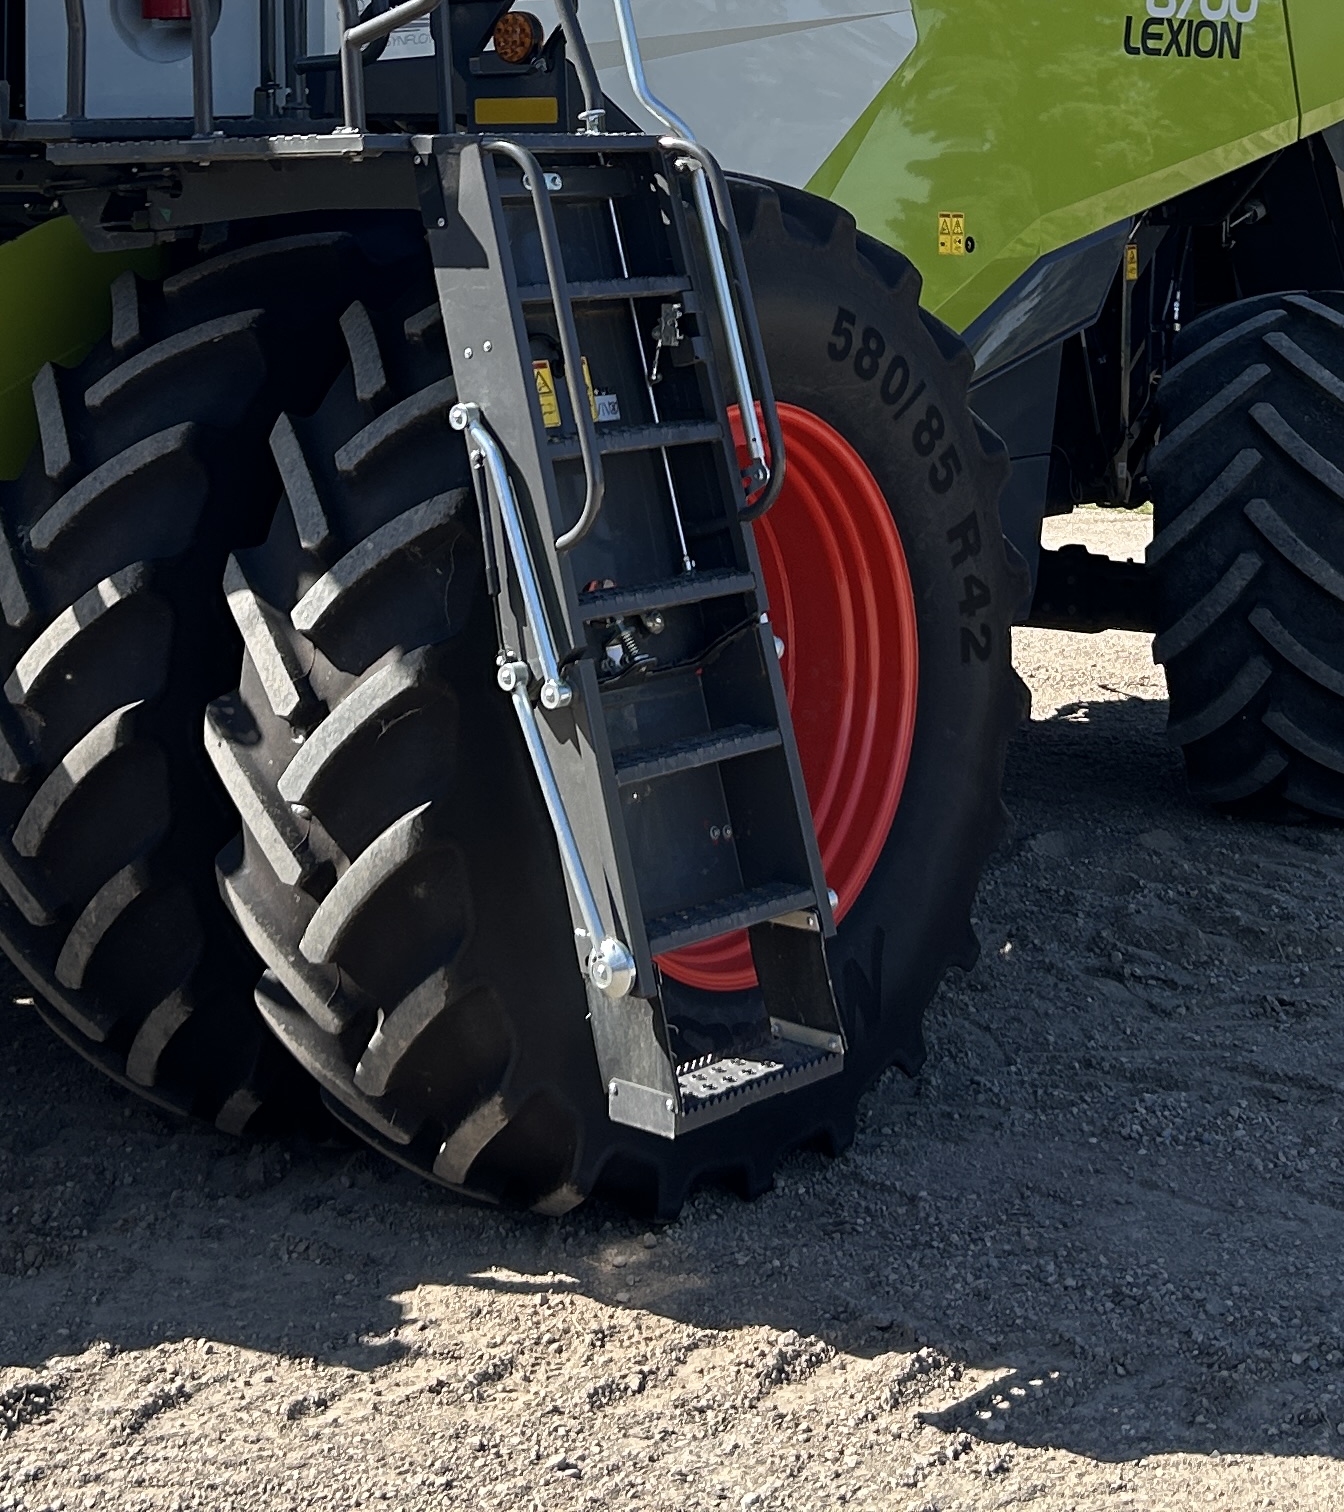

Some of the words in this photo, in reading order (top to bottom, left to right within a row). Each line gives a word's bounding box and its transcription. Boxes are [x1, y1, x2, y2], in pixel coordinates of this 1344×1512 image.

[387, 33, 432, 46] YNFLO
[1123, 16, 1243, 59] LEXION
[827, 306, 961, 494] 580/85
[946, 510, 992, 664] R42
